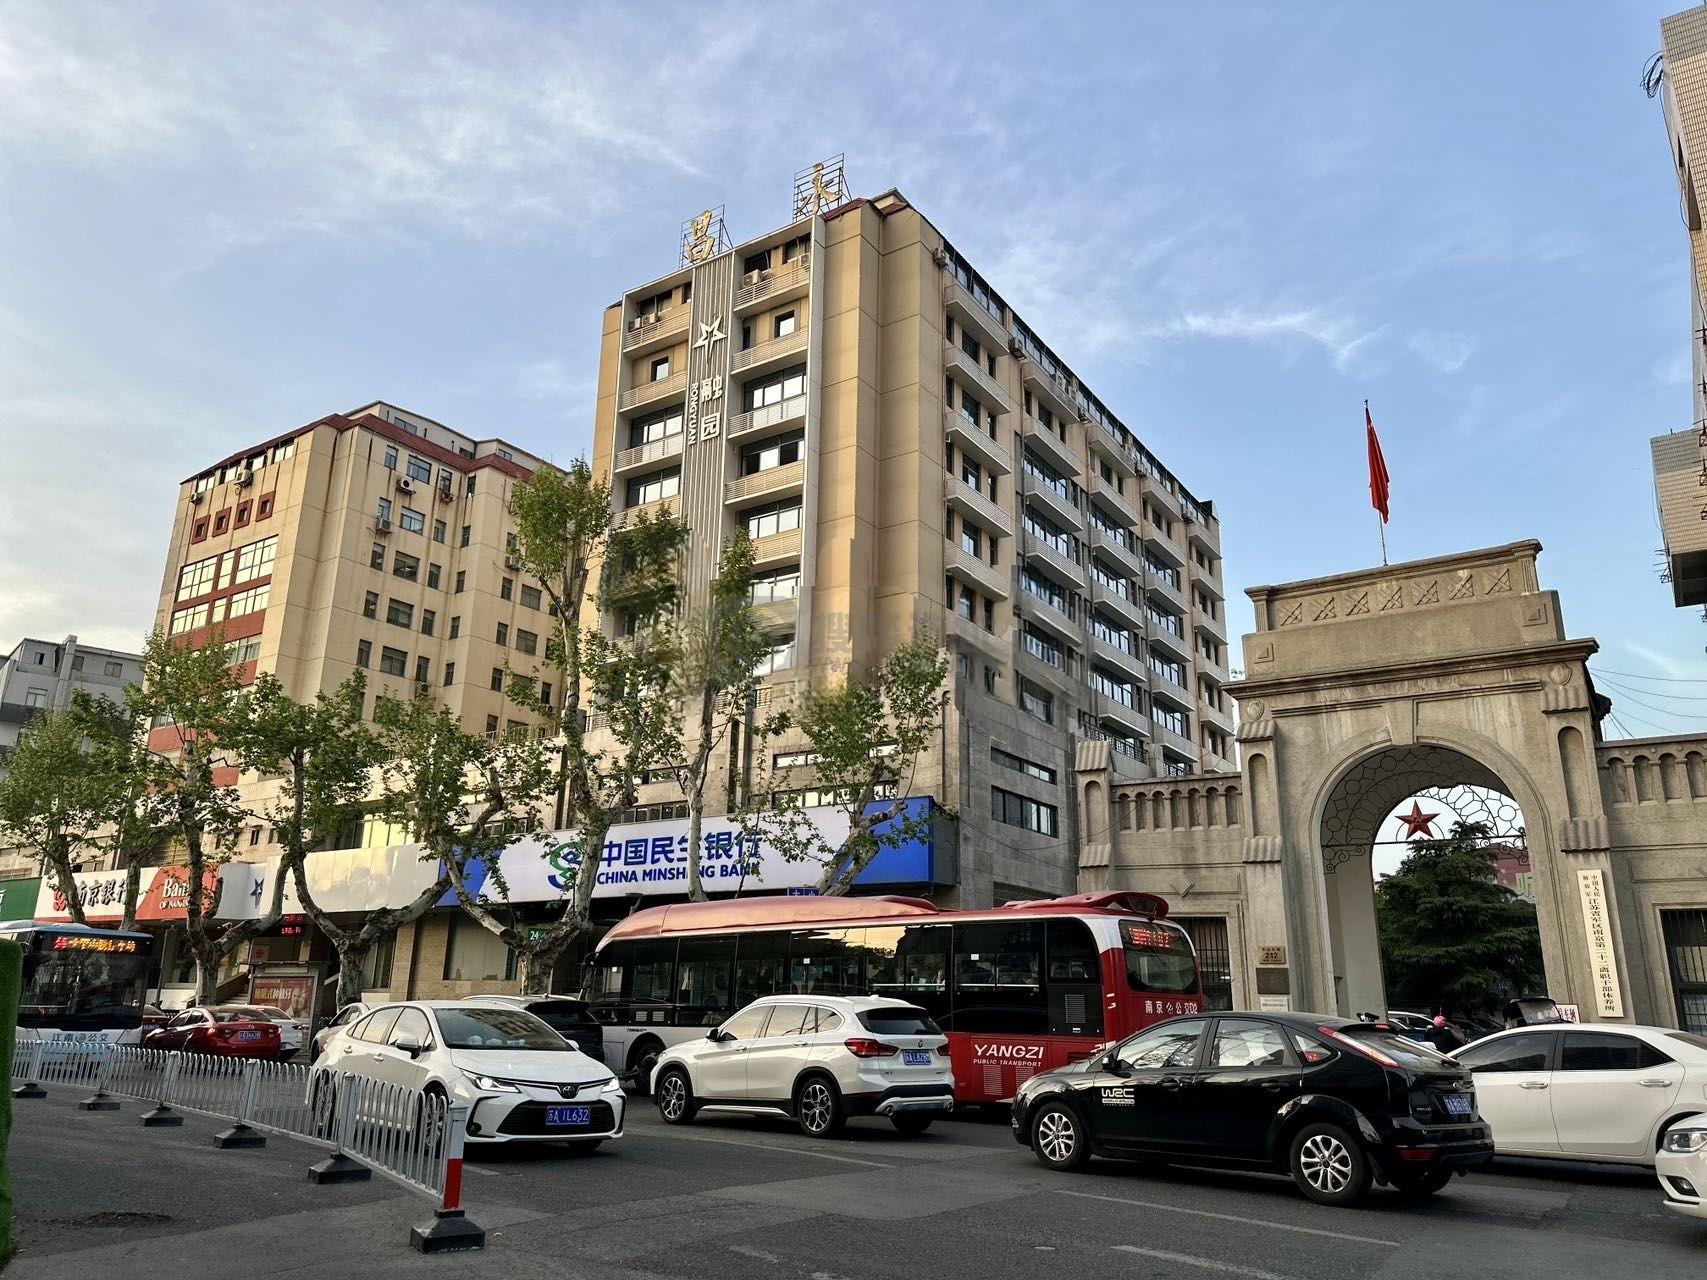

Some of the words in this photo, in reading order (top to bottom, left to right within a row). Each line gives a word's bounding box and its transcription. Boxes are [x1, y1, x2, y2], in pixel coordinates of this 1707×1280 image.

[688, 382, 699, 445] RONGYUAN
[700, 375, 723, 441] 融园
[597, 870, 638, 885] CHINA
[642, 866, 715, 881] MINSHNG
[974, 1044, 1044, 1059] YANGZI
[1101, 1088, 1135, 1098] WRC
